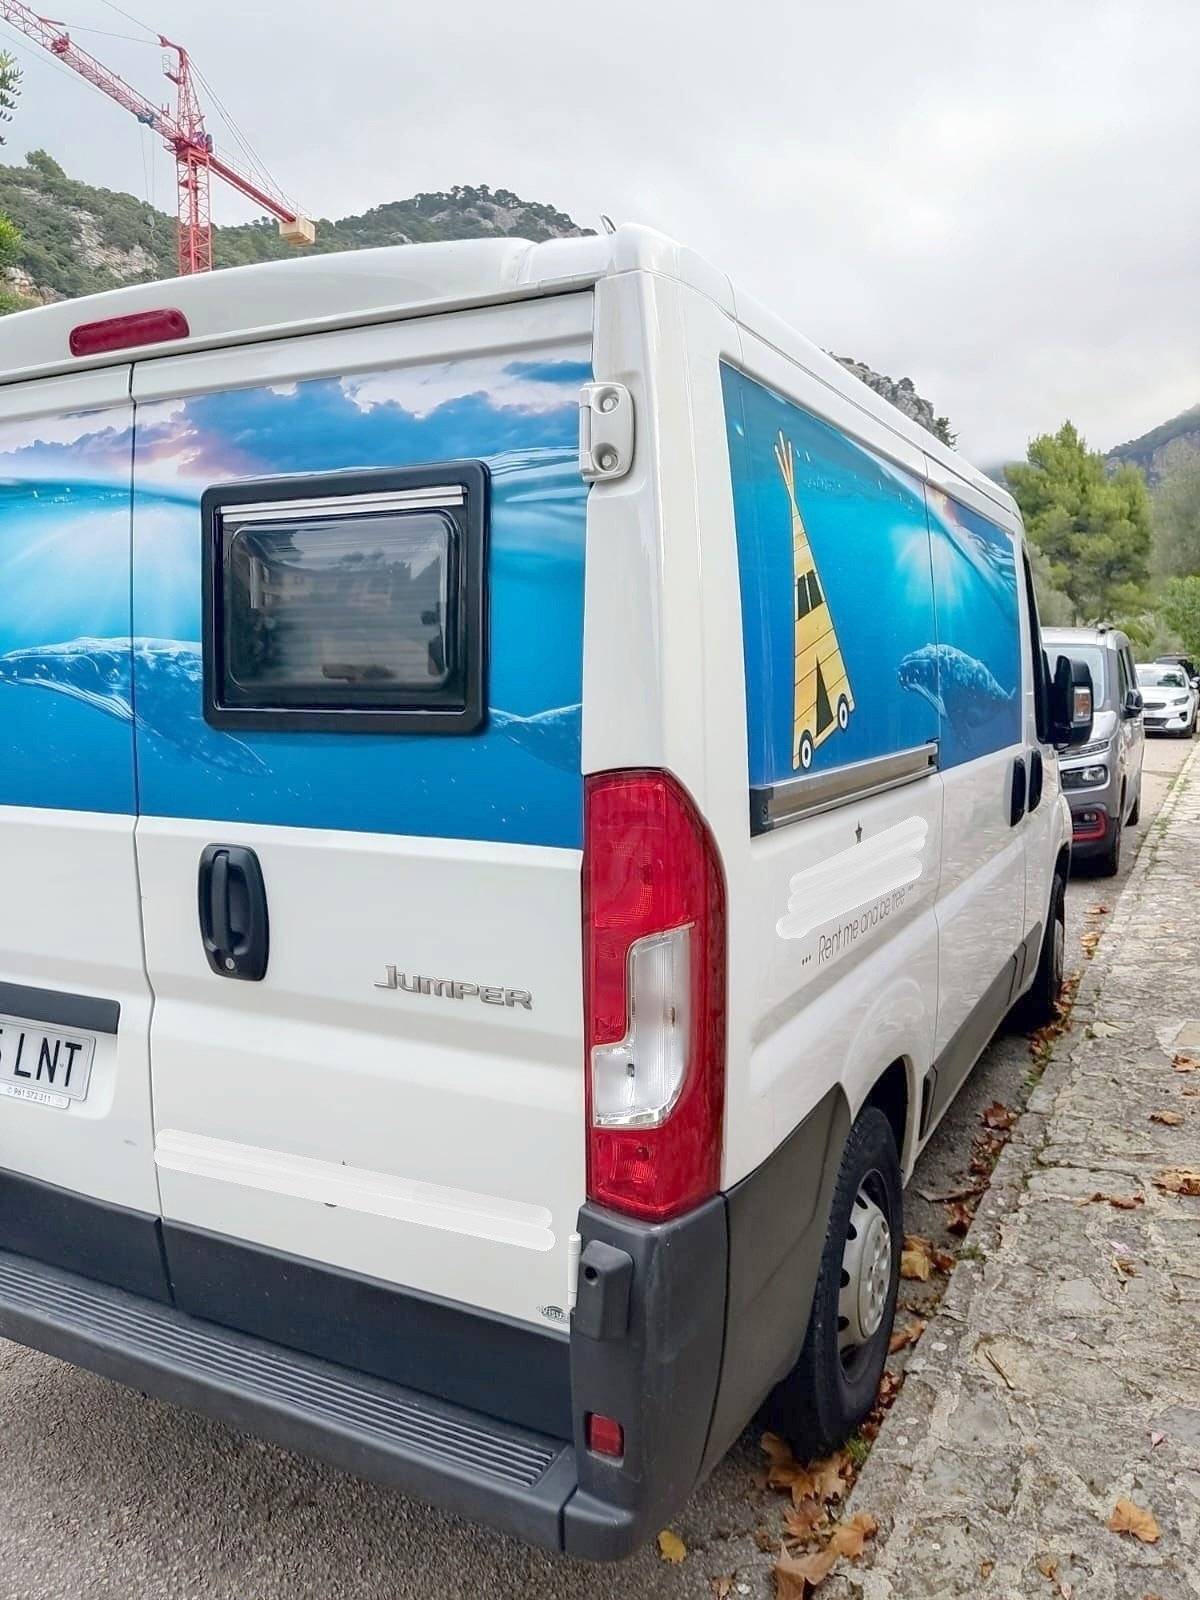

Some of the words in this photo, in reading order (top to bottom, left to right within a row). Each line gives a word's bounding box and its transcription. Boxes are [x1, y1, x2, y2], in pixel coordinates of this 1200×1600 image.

[818, 924, 841, 964] Rent
[843, 919, 858, 947] me
[860, 903, 878, 933] and
[14, 1033, 82, 1087] LNT
